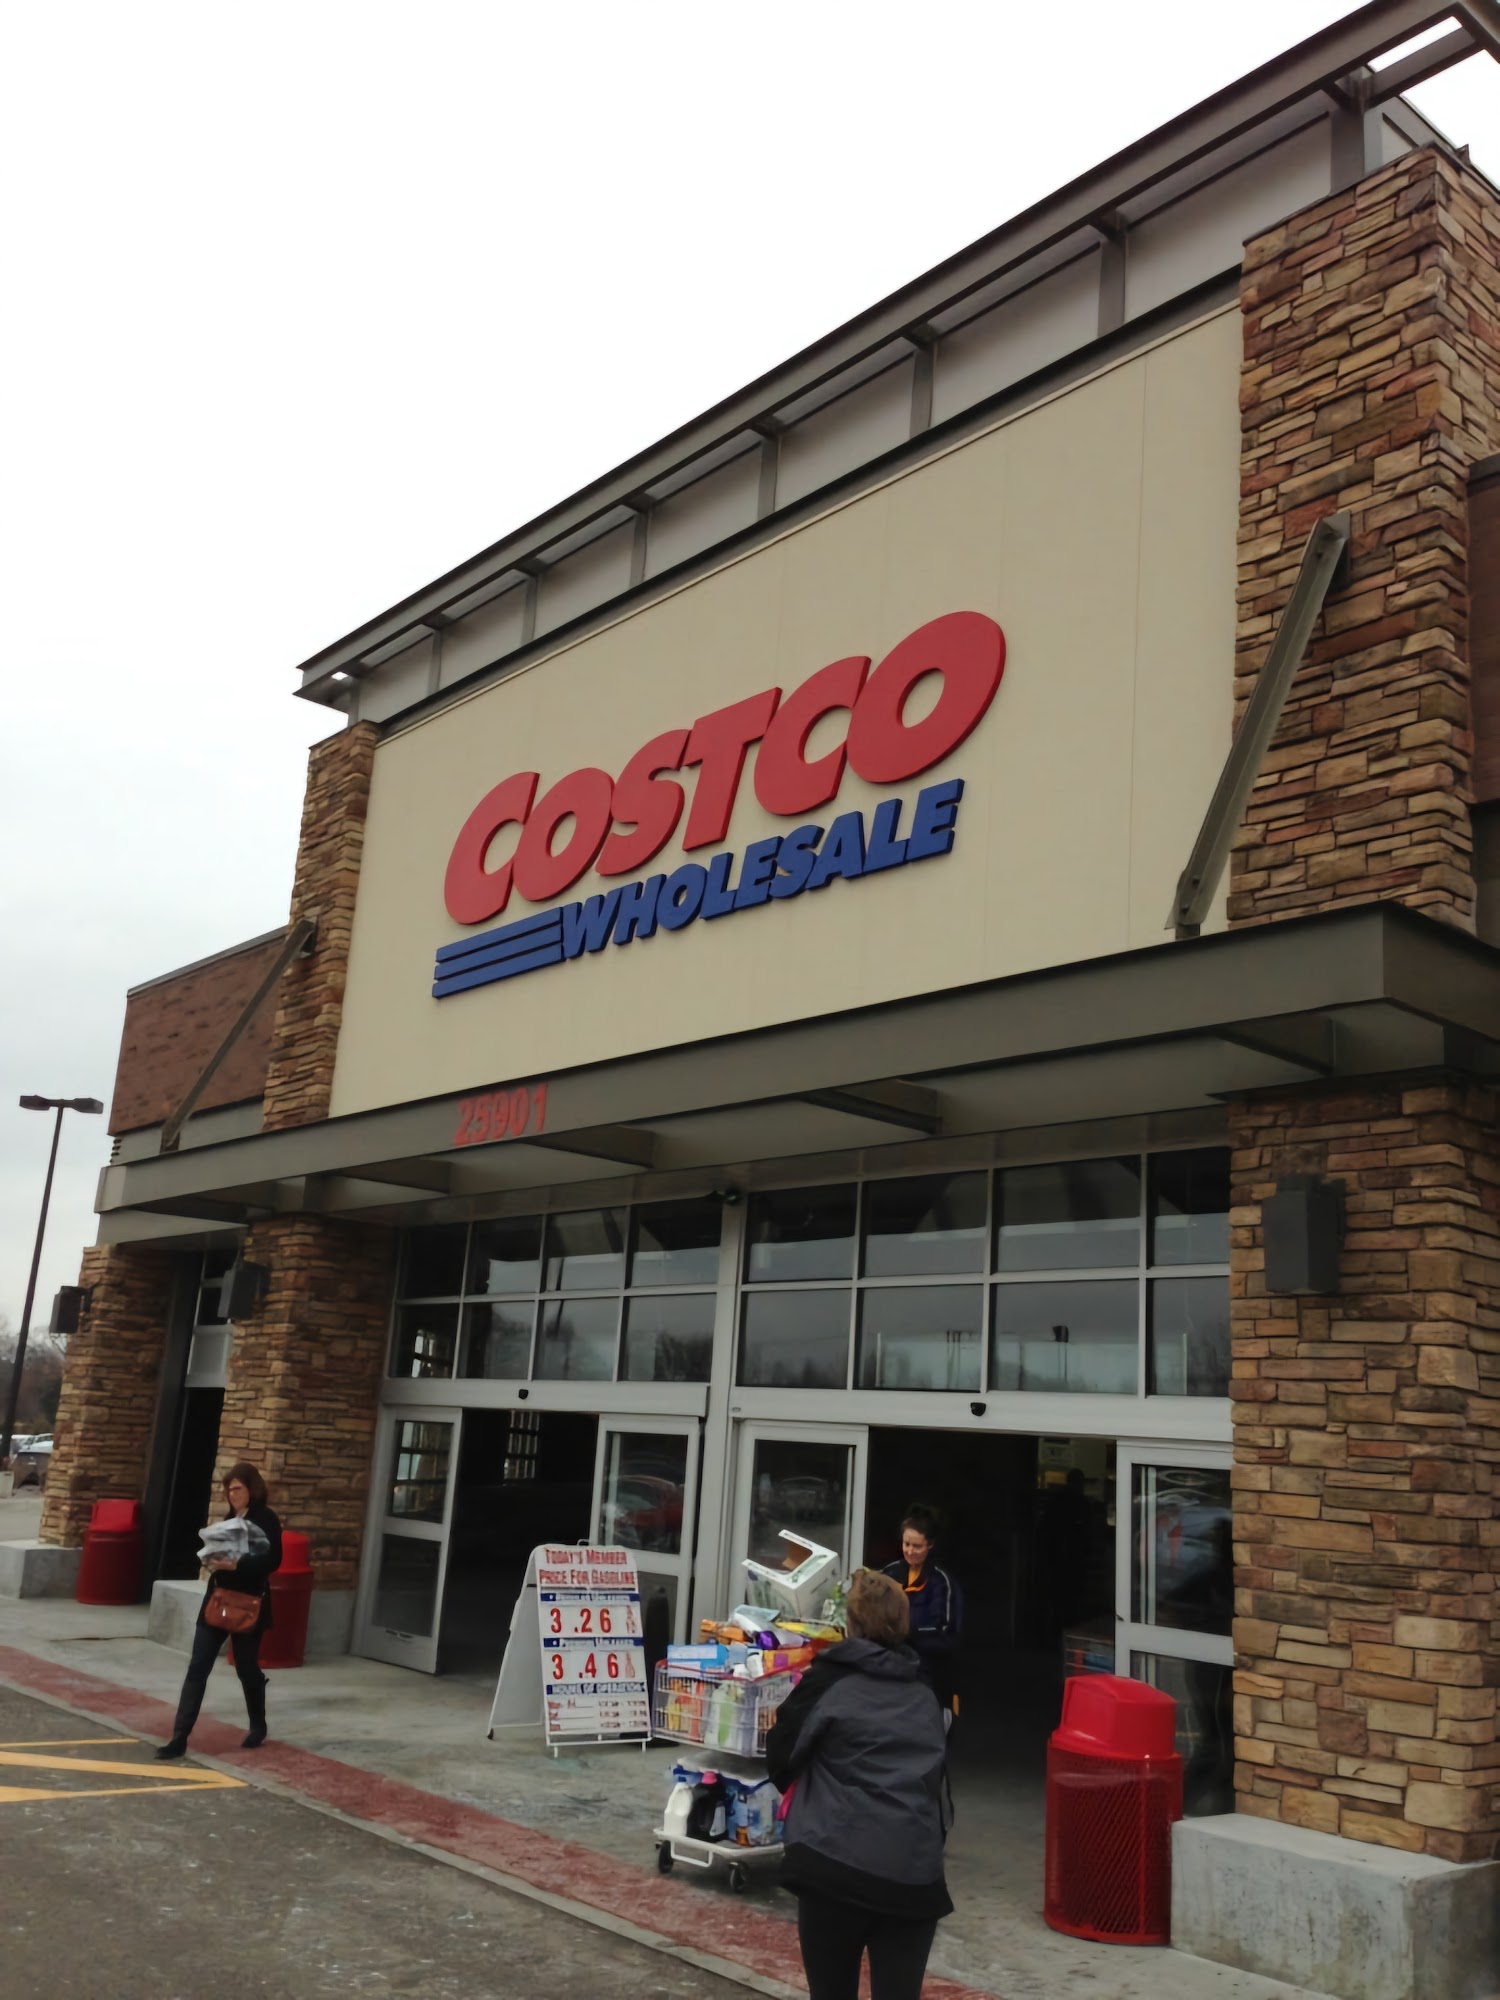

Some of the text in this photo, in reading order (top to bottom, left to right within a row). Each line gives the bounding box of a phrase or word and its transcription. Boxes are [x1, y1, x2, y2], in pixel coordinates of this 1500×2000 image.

[444, 610, 1006, 925] COSTCO
[560, 778, 965, 960] WHOLESALE
[453, 1083, 548, 1148] 25901
